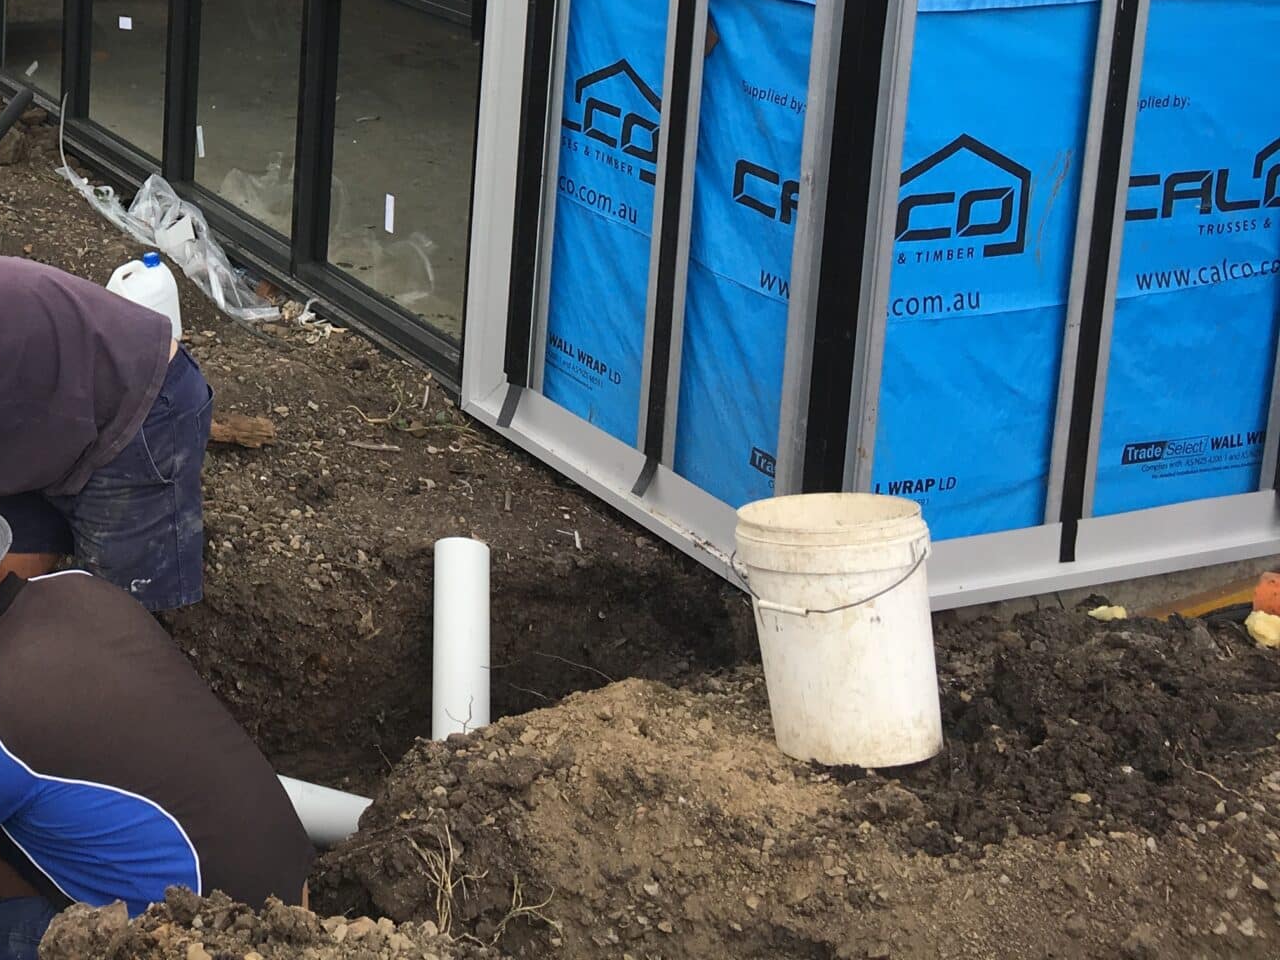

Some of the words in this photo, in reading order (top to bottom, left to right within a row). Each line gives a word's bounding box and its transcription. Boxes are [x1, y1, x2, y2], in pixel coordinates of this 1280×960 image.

[742, 79, 787, 106] Supplied
[595, 150, 633, 176] TIMBER
[1198, 218, 1257, 236] TRUSSES
[915, 247, 974, 263] TIMBER
[548, 331, 574, 358] WALL
[577, 348, 607, 376] WRAP
[608, 367, 621, 385] LD
[1125, 445, 1162, 462] Trade
[1166, 440, 1205, 457] Select
[1210, 433, 1243, 451] WALL
[888, 478, 936, 496] WRAP
[938, 477, 958, 491] LD
